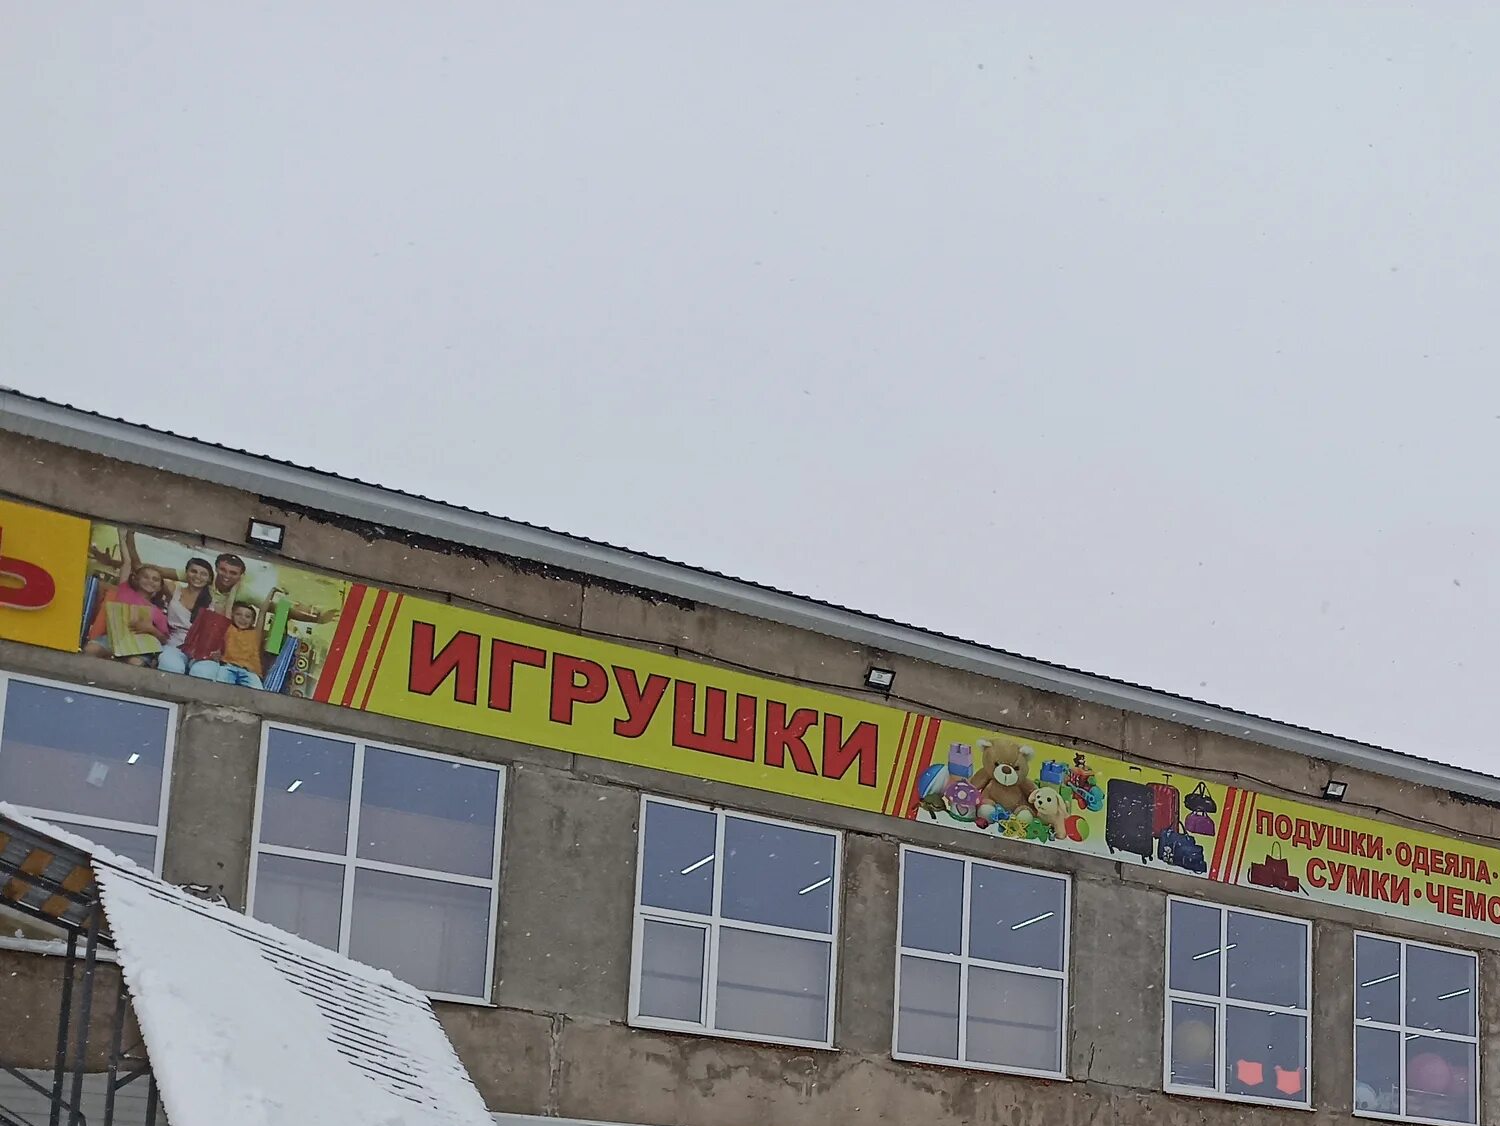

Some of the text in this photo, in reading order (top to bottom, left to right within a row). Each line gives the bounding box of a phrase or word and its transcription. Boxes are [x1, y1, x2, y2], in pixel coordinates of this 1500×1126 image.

[407, 620, 878, 788] ИГРУШКИ
[1256, 809, 1383, 861] ПОДУШКИ
[1395, 841, 1491, 885] ОДЕЯЛА
[1306, 857, 1410, 906] СУМКИ
